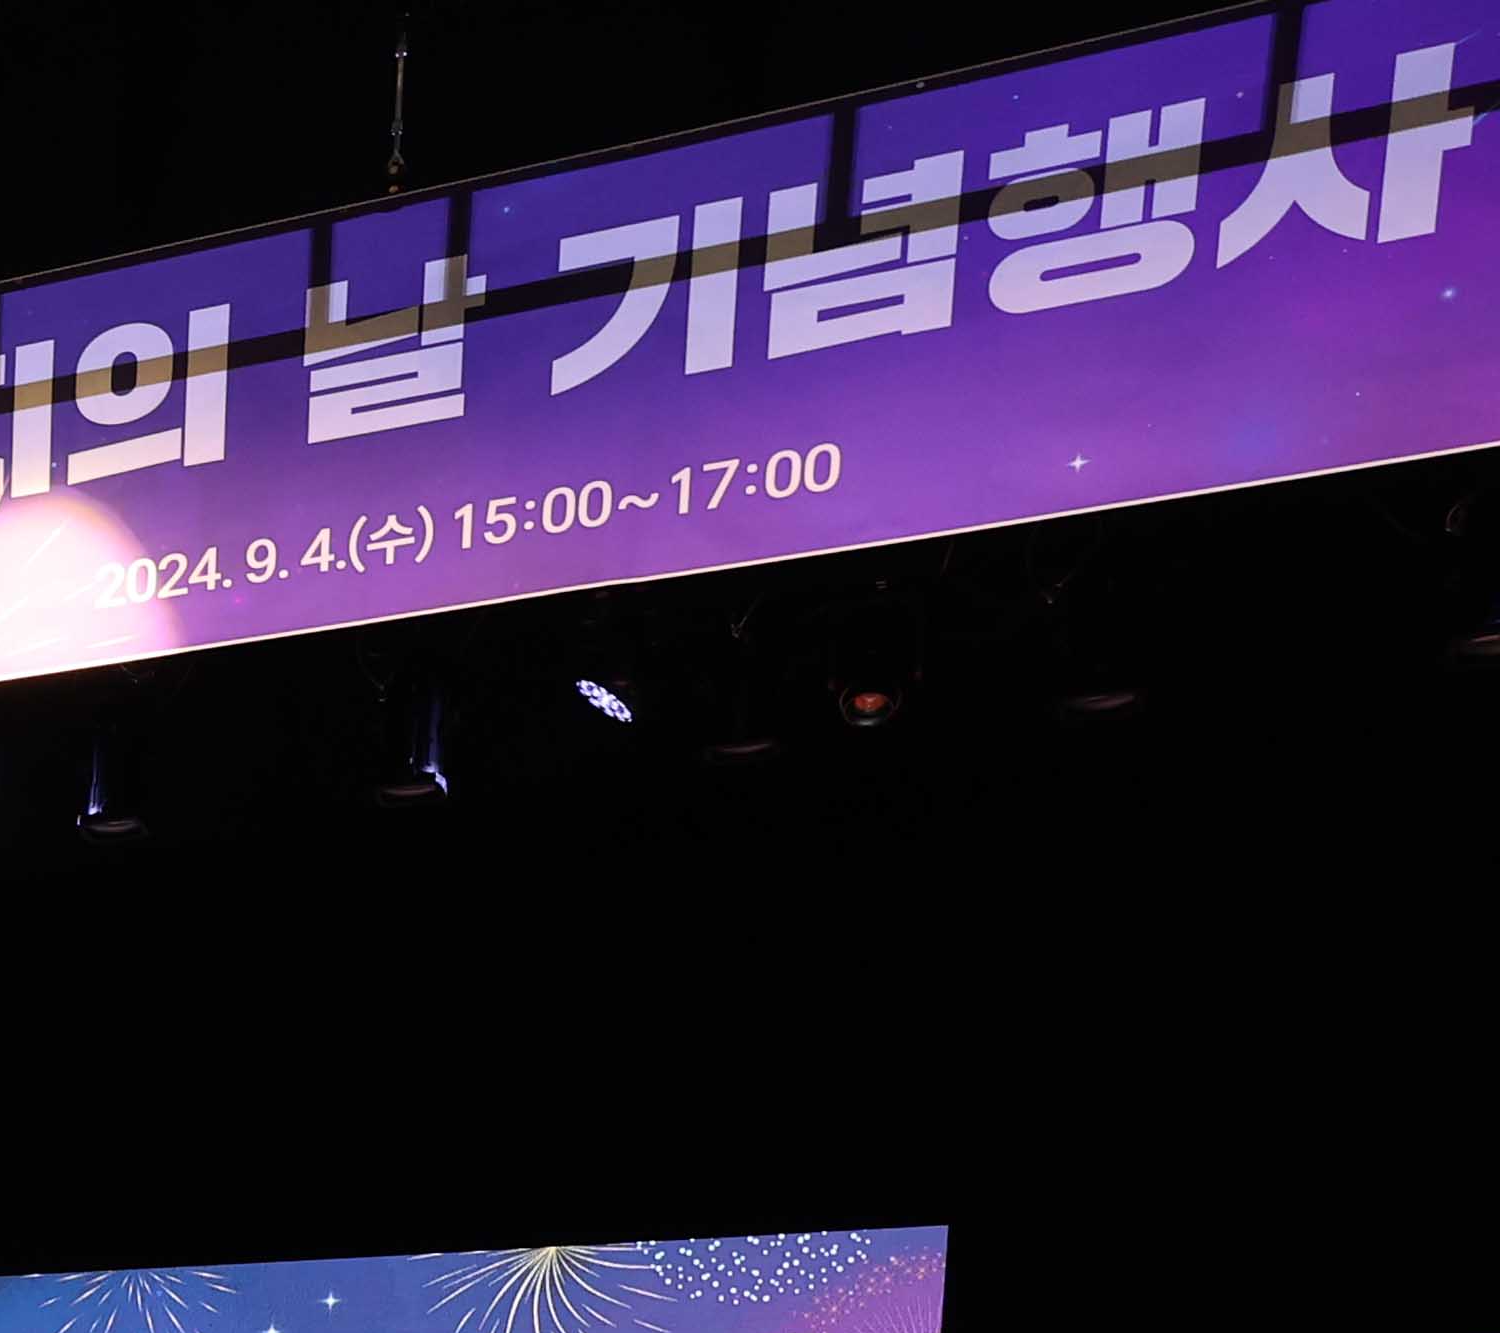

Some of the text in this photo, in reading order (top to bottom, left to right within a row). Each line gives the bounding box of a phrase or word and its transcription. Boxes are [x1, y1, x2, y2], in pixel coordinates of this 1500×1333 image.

[304, 253, 486, 444] 날
[550, 42, 1475, 396] 기념행사
[93, 442, 843, 610] 2024. 9. 4.(수) 15:00~17:00
